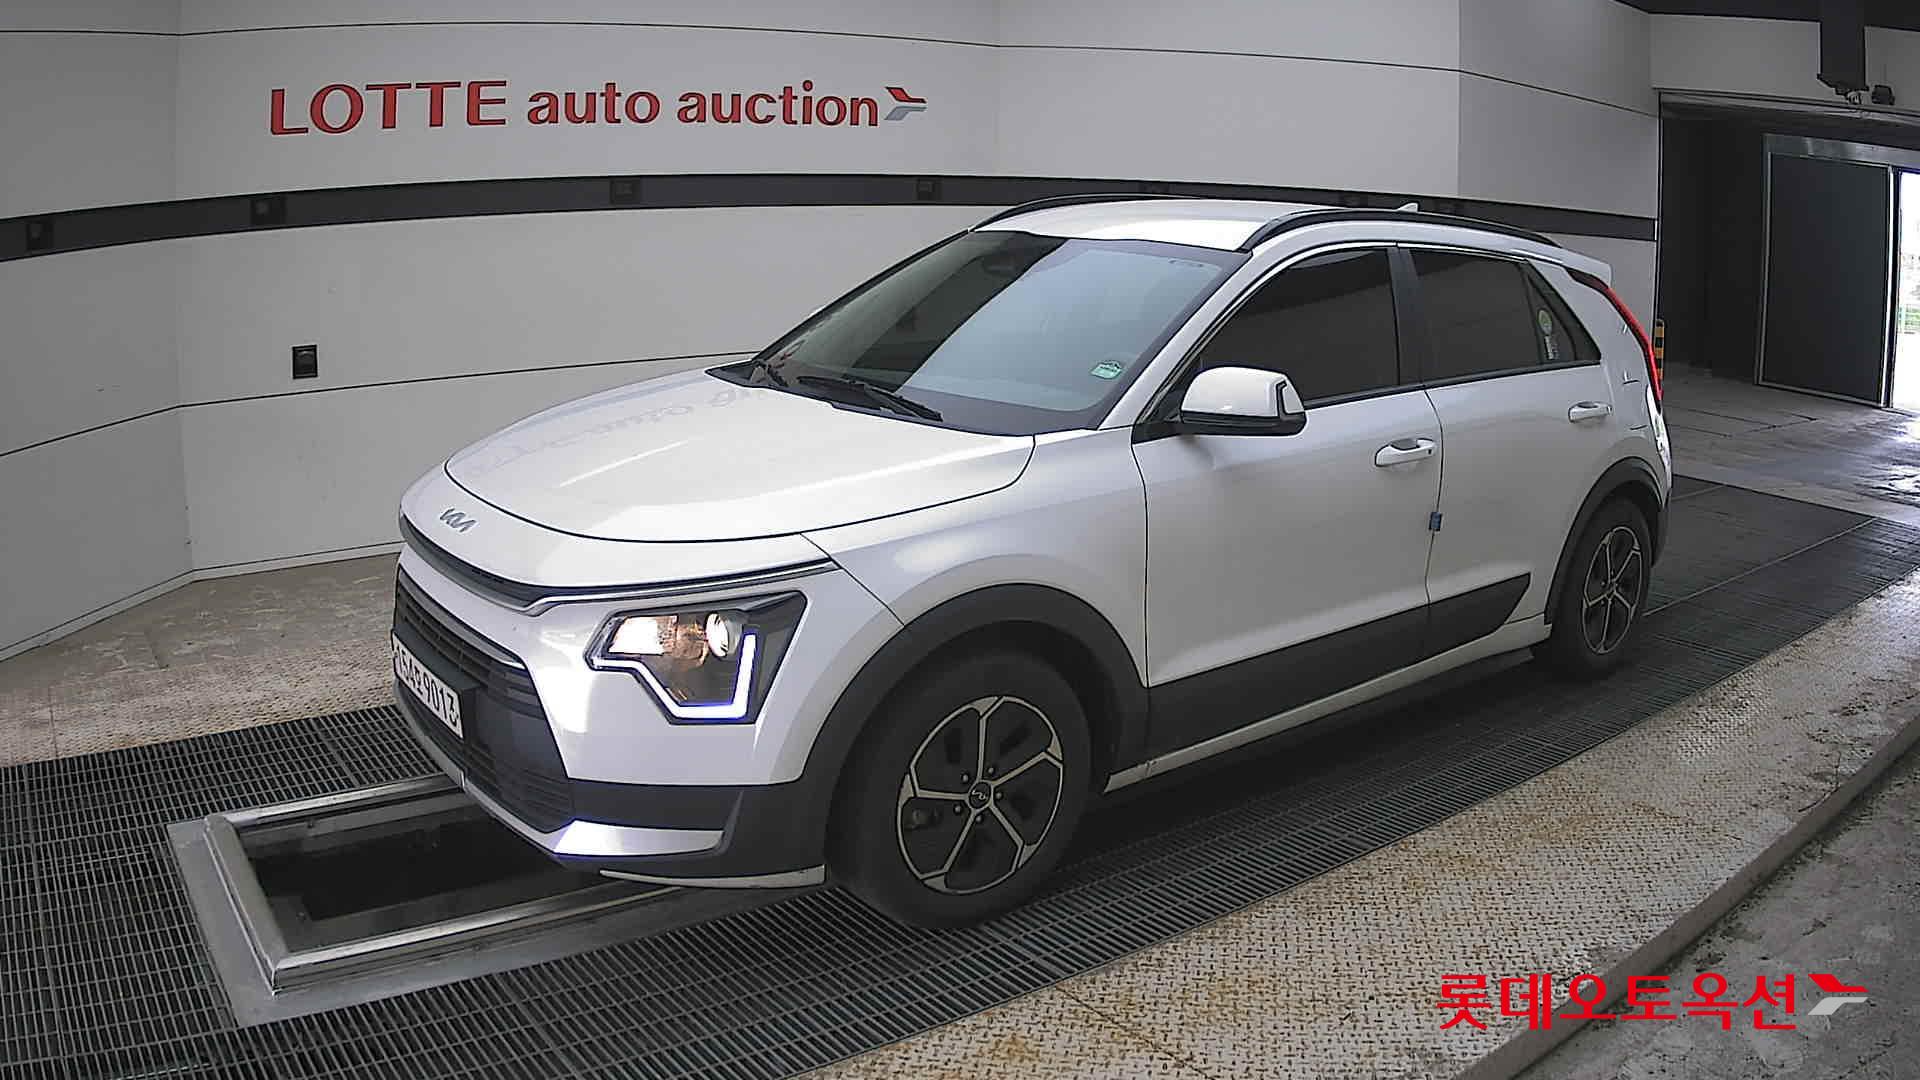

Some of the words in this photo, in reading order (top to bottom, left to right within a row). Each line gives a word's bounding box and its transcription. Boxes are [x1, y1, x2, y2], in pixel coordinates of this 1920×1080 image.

[270, 80, 507, 136] LOTTE
[527, 81, 662, 126] auto
[676, 80, 880, 127] auction
